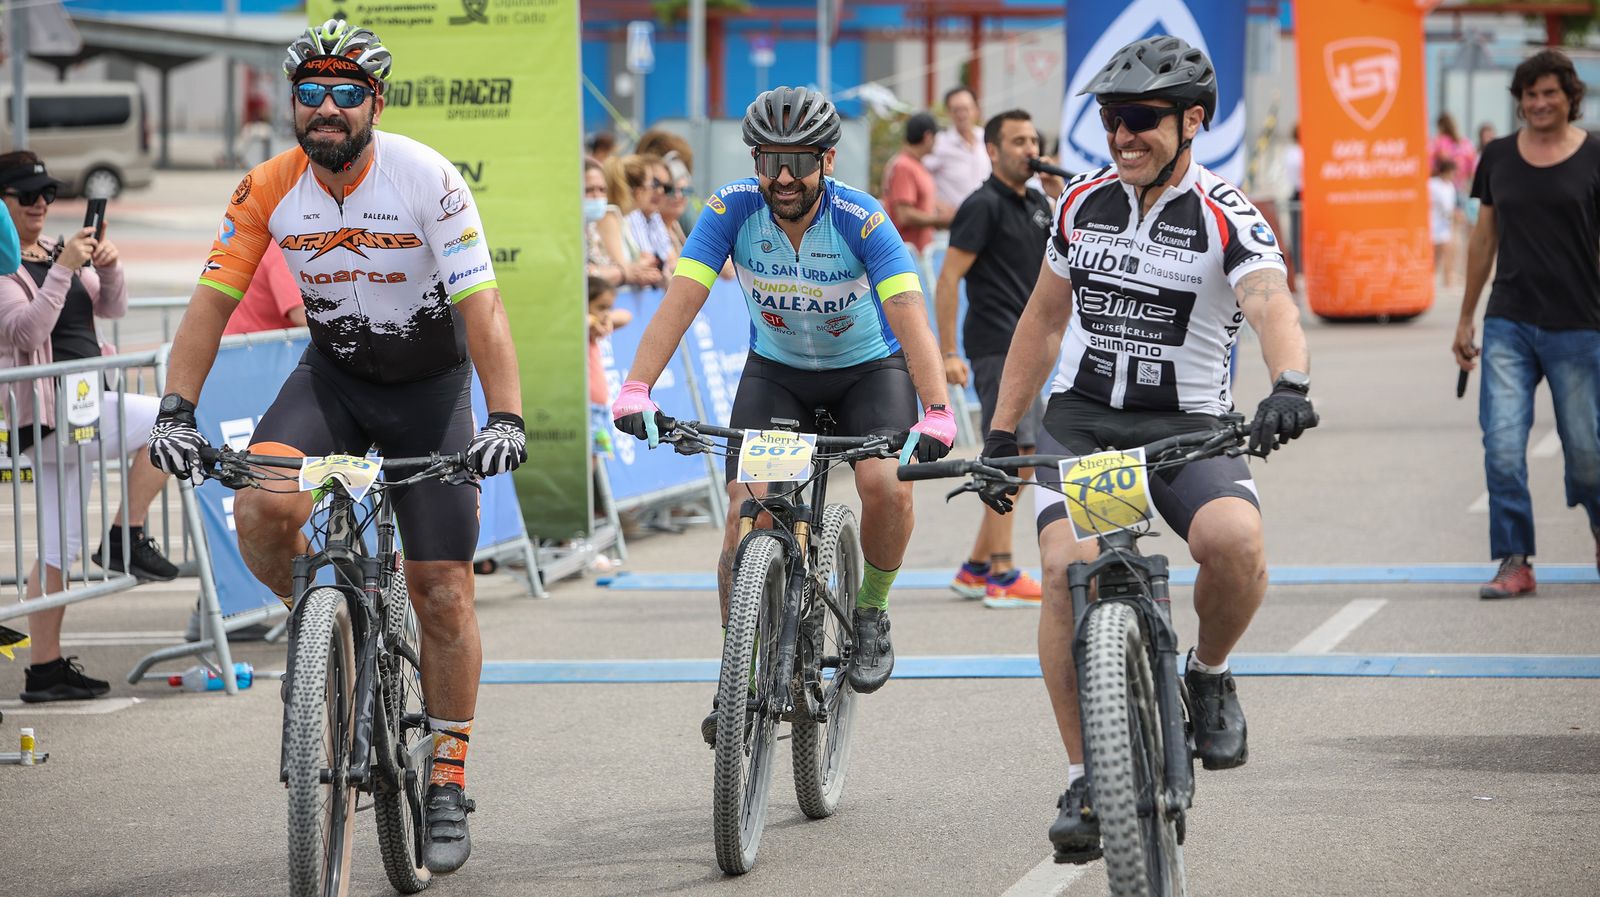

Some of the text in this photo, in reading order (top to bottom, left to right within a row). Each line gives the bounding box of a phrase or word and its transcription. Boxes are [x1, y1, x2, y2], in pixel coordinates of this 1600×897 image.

[449, 78, 513, 106] RACER
[363, 212, 399, 222] BALEARIA
[1087, 222, 1119, 232] SHIMANO
[1158, 222, 1198, 237] Cascades
[772, 263, 798, 276] SAN
[1143, 262, 1203, 285] Chaussures
[1090, 336, 1162, 357] SHIMANO
[748, 445, 806, 457] 567
[1072, 466, 1137, 501] 740
